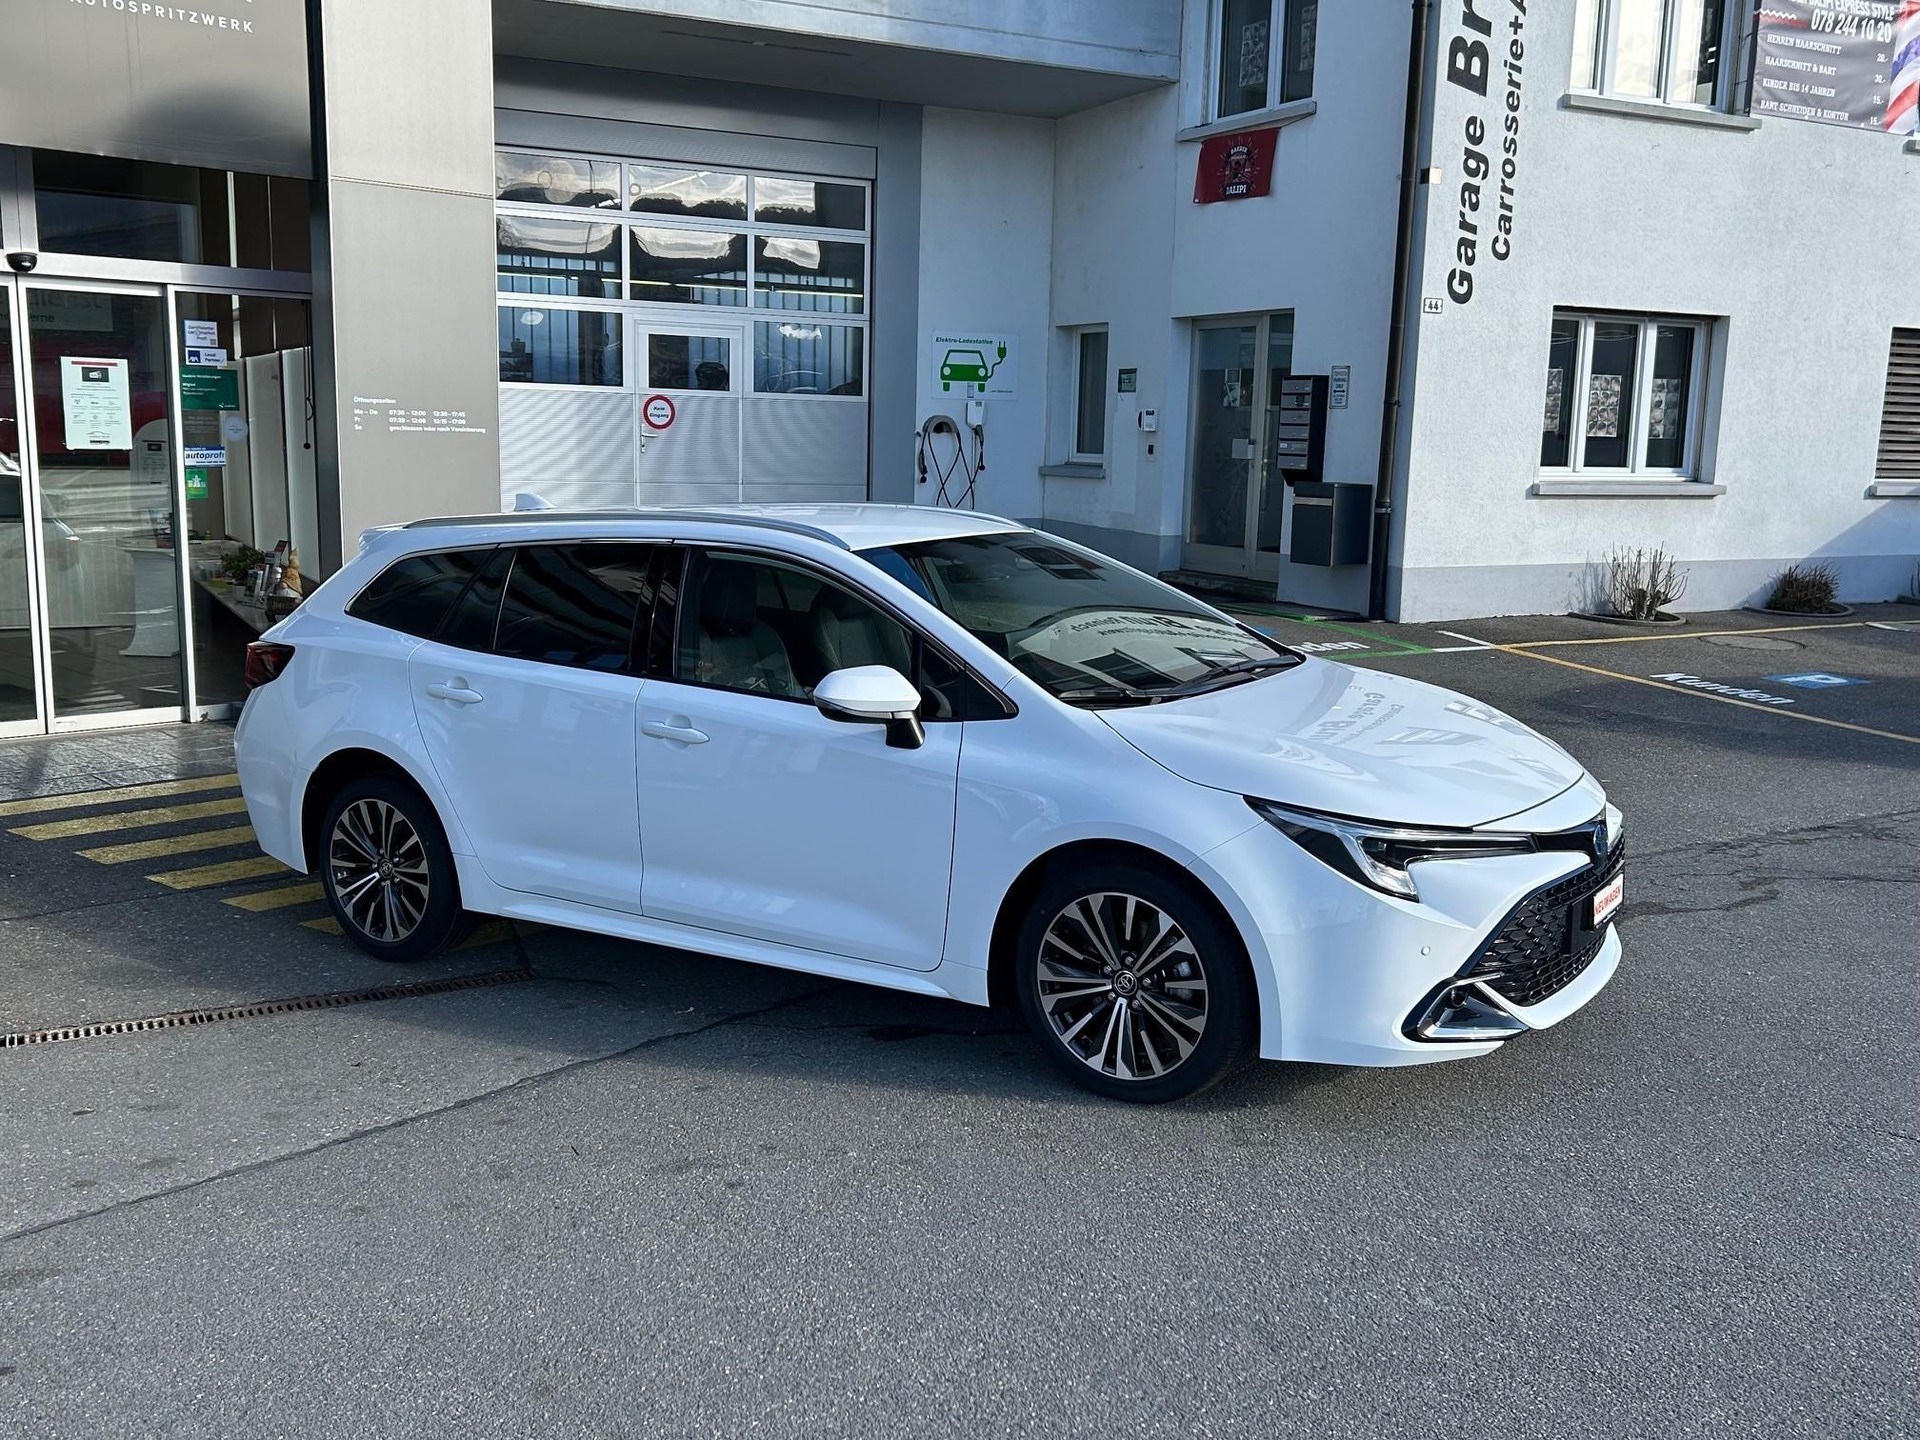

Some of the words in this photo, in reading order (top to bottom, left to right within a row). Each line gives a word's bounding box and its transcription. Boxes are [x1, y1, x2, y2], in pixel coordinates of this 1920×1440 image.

[70, 0, 253, 33] TOSPRITZWERK
[1834, 0, 1871, 17] EXPRESS
[1871, 3, 1895, 21] STYLE
[1810, 8, 1835, 33] 078
[1834, 14, 1859, 37] 244
[1860, 18, 1875, 40] 10
[1876, 21, 1892, 43] 20
[1766, 33, 1795, 47] HERREN
[1795, 38, 1842, 55] HAARSCHNITT
[1764, 55, 1812, 72] HAARSCHNITT
[1812, 63, 1818, 73] &
[1818, 65, 1837, 76] BART
[1762, 77, 1788, 90] KINDER
[1788, 82, 1800, 92] BIS
[1801, 84, 1809, 94] 14
[1809, 85, 1836, 97] JAHREN
[1760, 99, 1779, 110] BART
[1779, 102, 1816, 117] SCHNEIDEN
[1816, 108, 1822, 117] &
[1446, 115, 1490, 305] Garage
[1428, 300, 1439, 311] 44
[935, 336, 993, 345] Elektro-Ladestation
[185, 451, 225, 460] autoprofi
[1287, 641, 1371, 653] nden
[1650, 671, 1796, 705] Kunden
